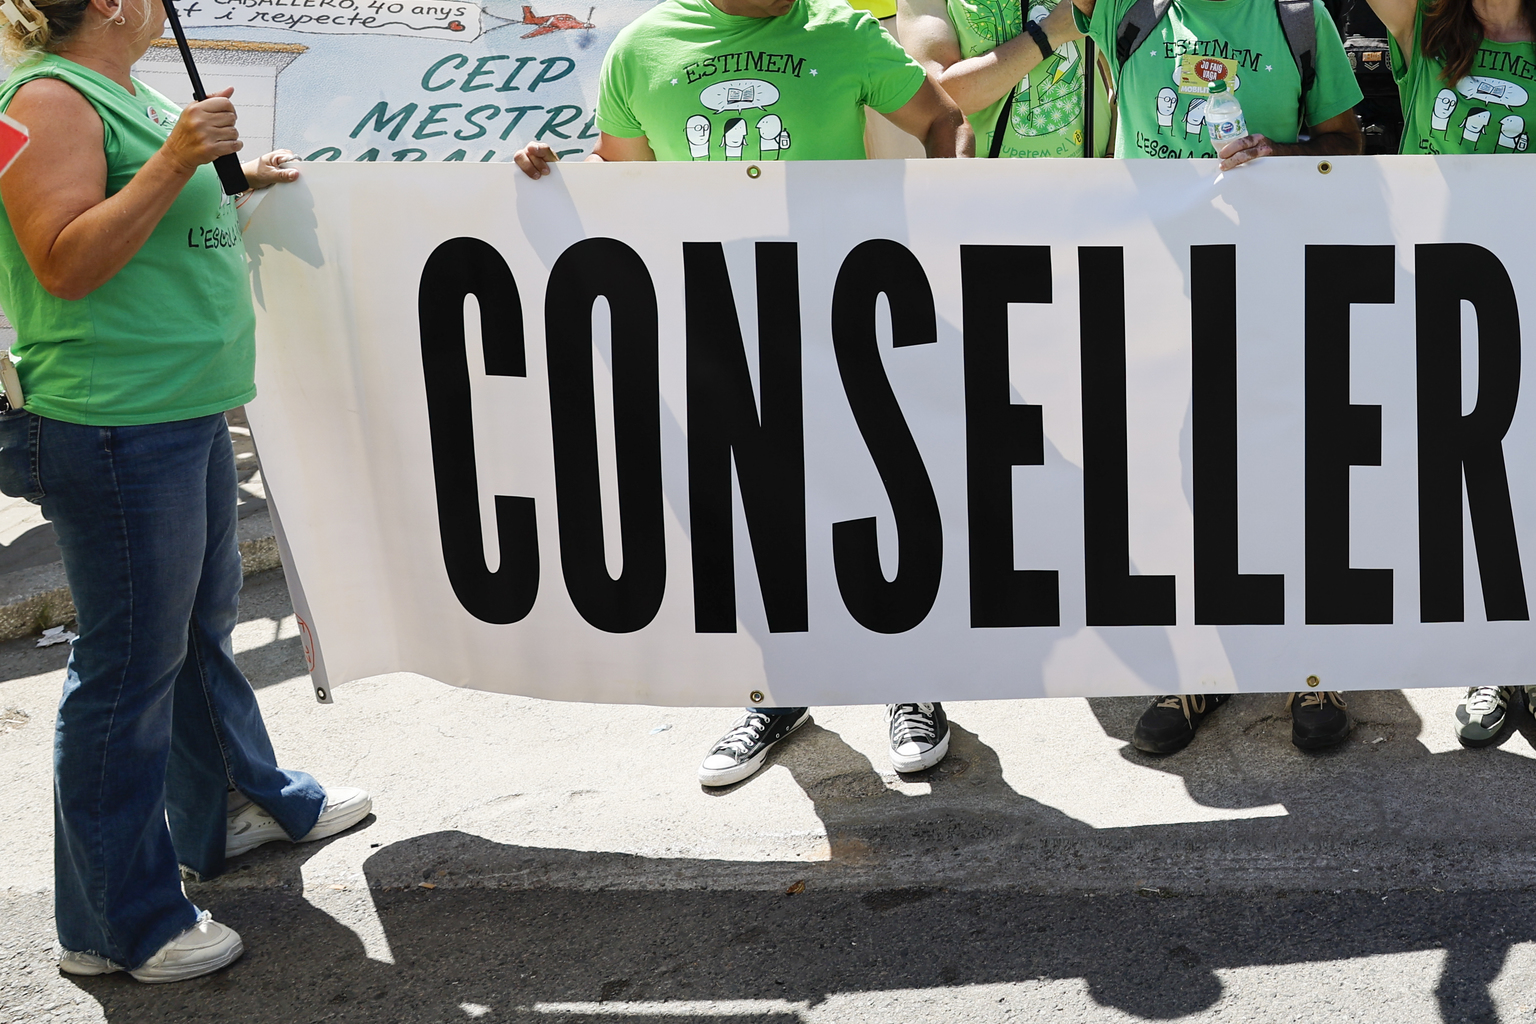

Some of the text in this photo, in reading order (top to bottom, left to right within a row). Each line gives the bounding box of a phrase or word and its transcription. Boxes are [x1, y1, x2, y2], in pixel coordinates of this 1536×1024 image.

[214, 7, 379, 29] i respecte
[368, 0, 403, 14] 40
[412, 4, 466, 19] anys
[420, 53, 576, 94] CEIP
[683, 50, 806, 84] ESTIMEM
